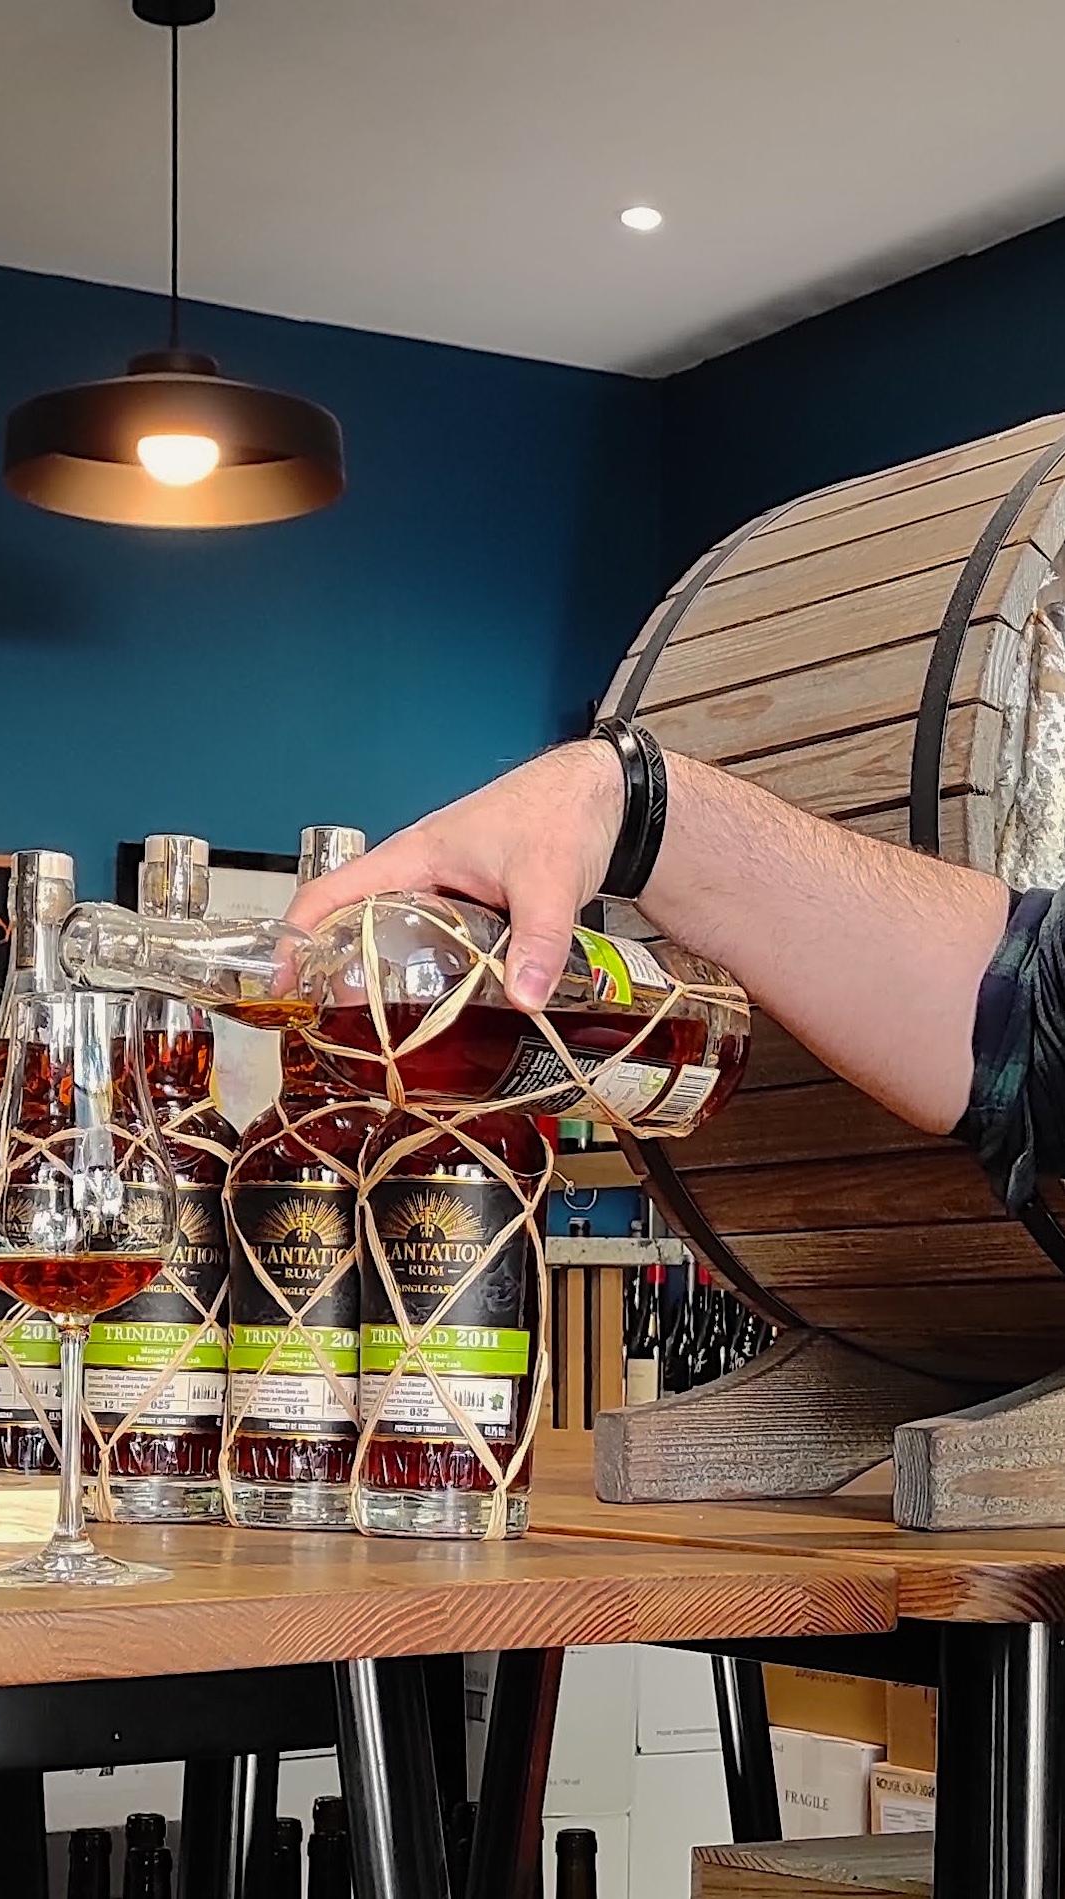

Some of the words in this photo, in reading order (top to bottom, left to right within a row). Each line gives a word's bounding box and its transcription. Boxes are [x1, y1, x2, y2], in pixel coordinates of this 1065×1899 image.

[171, 1245, 224, 1265] ATION
[249, 1246, 349, 1266] PLANTATIO
[382, 1241, 491, 1264] LANTATION
[284, 1267, 322, 1280] RUM
[408, 1265, 445, 1277] RUM
[143, 1284, 173, 1294] INGLE
[103, 1325, 190, 1343] TRINIDAD
[370, 1328, 449, 1345] TRINAD
[456, 1331, 499, 1349] 2011
[784, 1789, 830, 1811] FRAGILE
